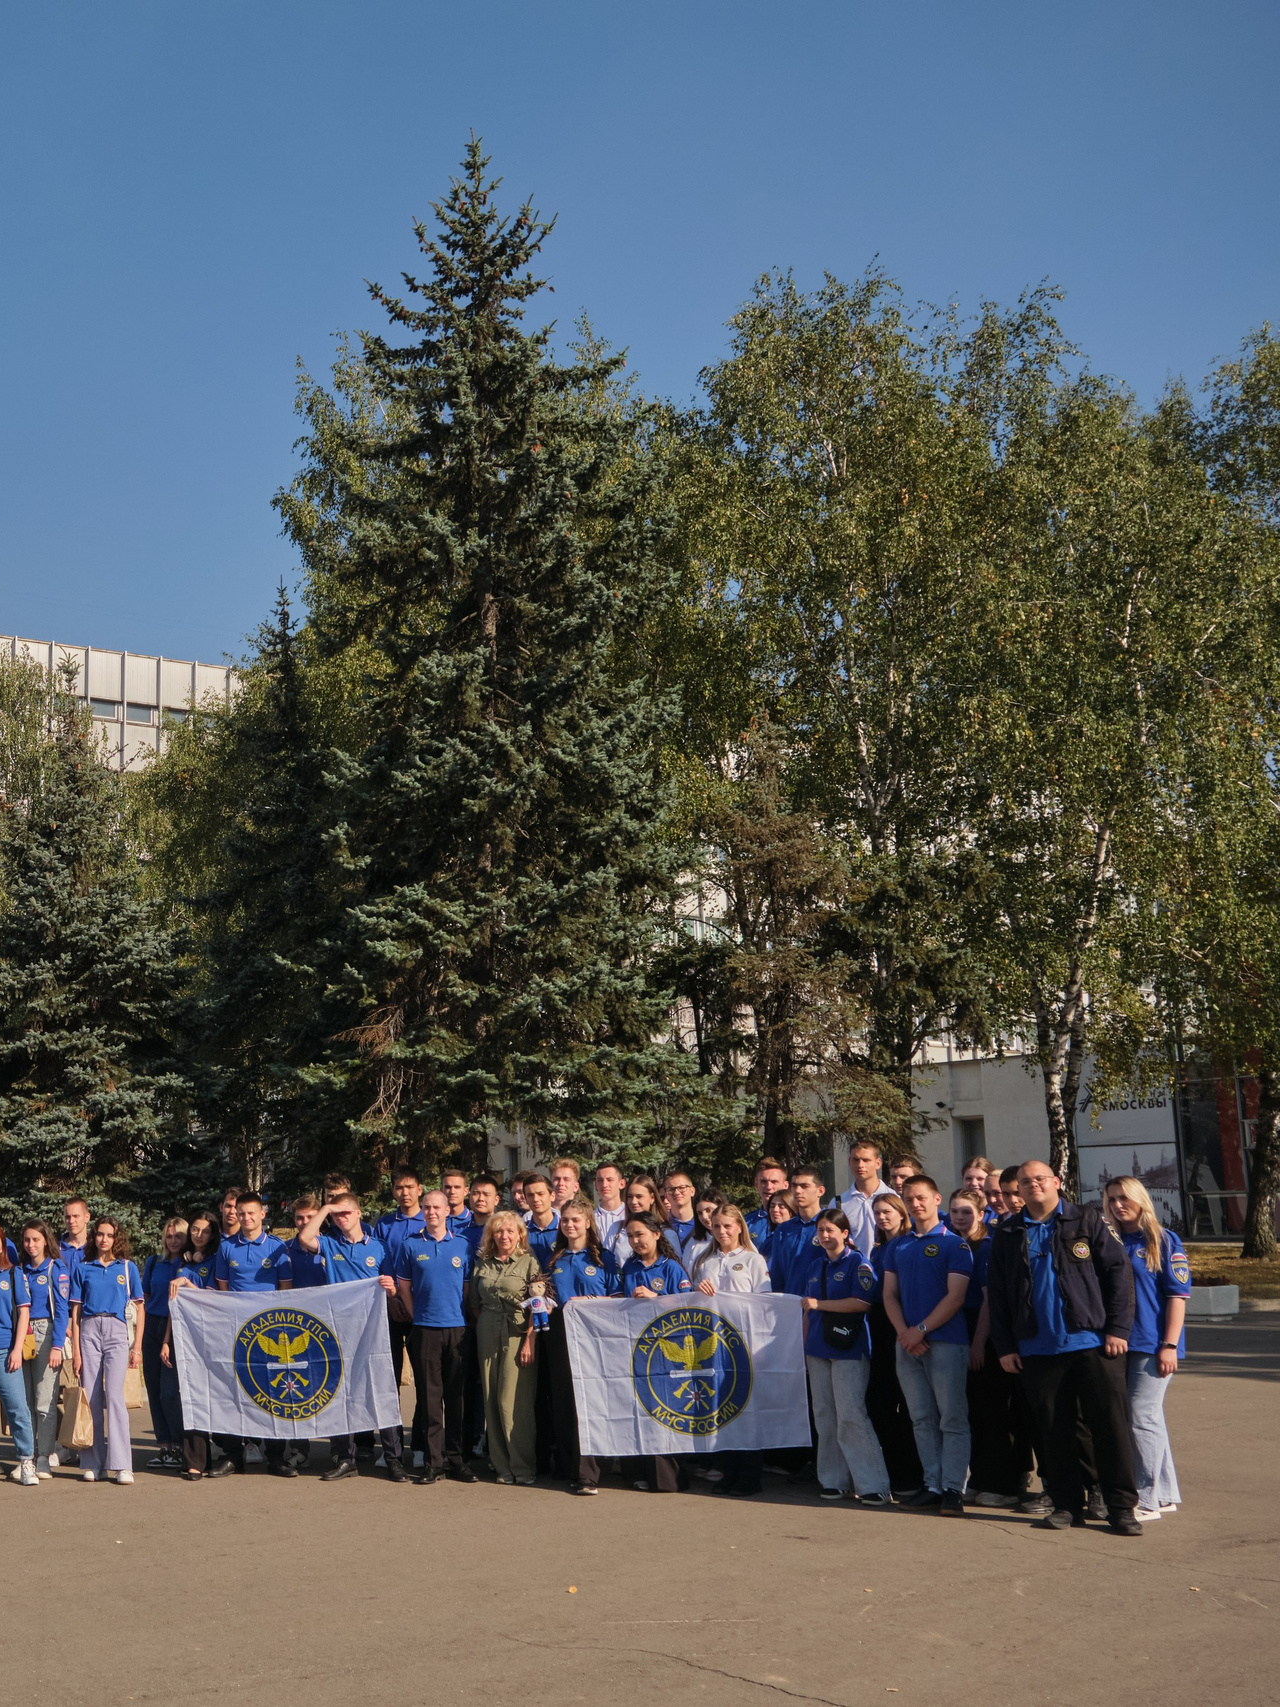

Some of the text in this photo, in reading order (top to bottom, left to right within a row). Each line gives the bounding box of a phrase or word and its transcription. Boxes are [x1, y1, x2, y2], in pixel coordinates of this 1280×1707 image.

[1108, 1098, 1167, 1112] МОСКВЫ
[239, 1312, 330, 1347] АКАДЕМИЯ ГПС
[638, 1312, 740, 1355] АКАДЕМИЯ ГПС
[253, 1388, 333, 1419] МЧС РОССИИ
[651, 1401, 739, 1433] МЧС РОССИИ
